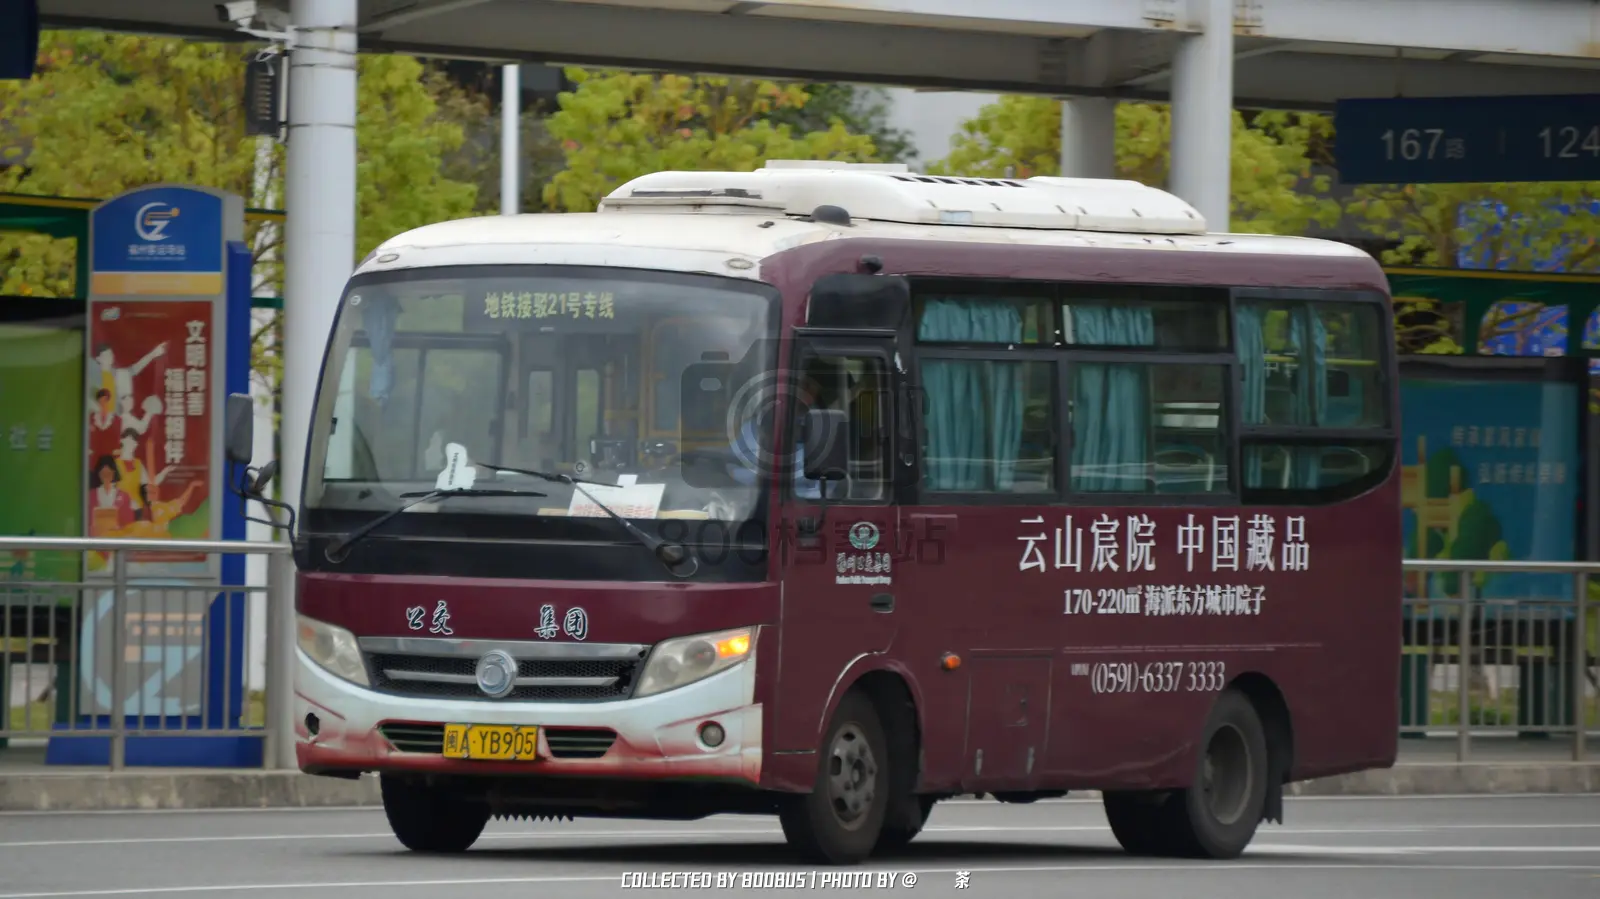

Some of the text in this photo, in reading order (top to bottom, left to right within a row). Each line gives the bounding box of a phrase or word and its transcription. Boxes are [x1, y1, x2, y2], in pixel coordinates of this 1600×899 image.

[484, 291, 615, 319] 地铁接驳21号专线
[1017, 513, 1310, 573] 云山宸院 中国藏品
[1144, 584, 1267, 616] 海派东方城市院子
[406, 600, 589, 641] 公交 集团
[1091, 661, 1183, 694] (0591)-6337
[1186, 661, 1226, 692] 3333
